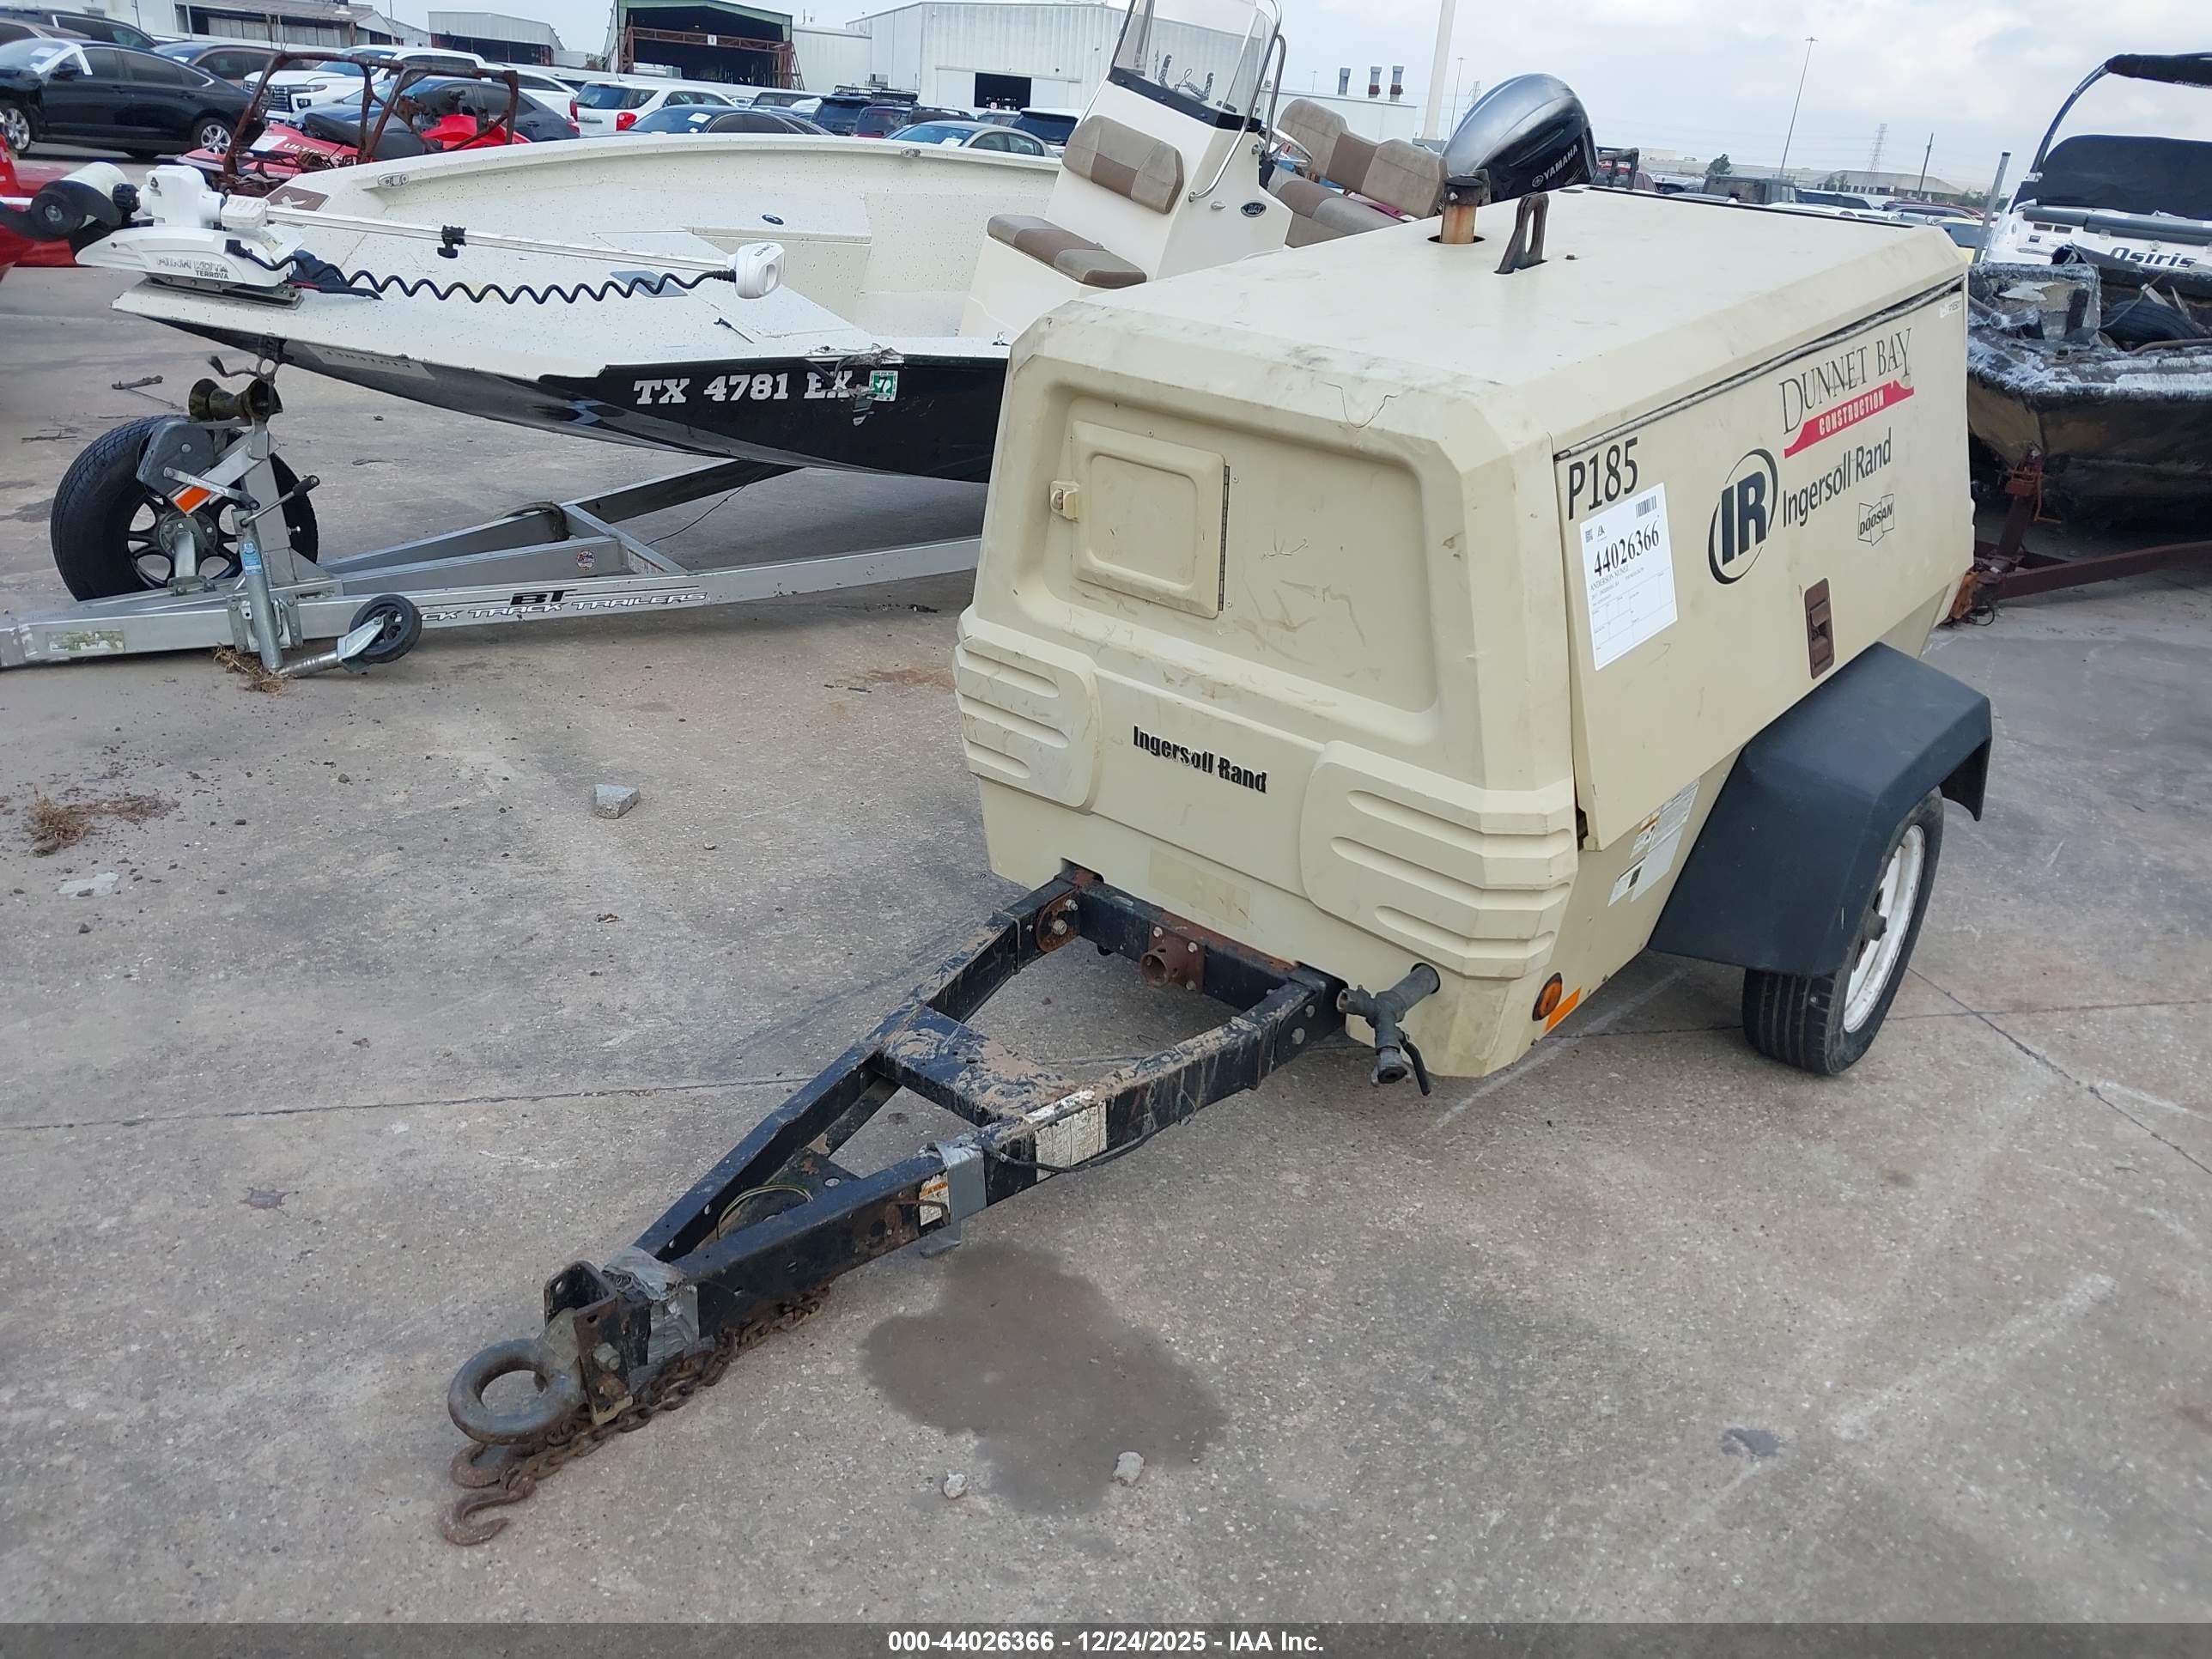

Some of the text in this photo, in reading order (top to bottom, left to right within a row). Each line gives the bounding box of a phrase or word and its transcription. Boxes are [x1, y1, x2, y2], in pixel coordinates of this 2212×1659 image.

[1543, 144, 1578, 179] YAMAHA
[196, 270, 229, 280] TERROVA
[2109, 246, 2198, 268] Osiris
[633, 378, 690, 404] TX
[703, 373, 788, 402] 4781
[1778, 327, 1911, 434] DUNNET BAY
[1818, 389, 1885, 435] CONSTRUCTION
[1569, 436, 1638, 520] P185
[1783, 427, 1892, 527] Ingersoll Rand
[1722, 471, 1767, 567] IR
[1859, 501, 1893, 536] DOOSAN
[1593, 520, 1660, 577] 44026366
[469, 602, 566, 618] TRACK
[571, 592, 708, 610] TRAILERS
[1133, 725, 1267, 793] Ingersoll Rand
